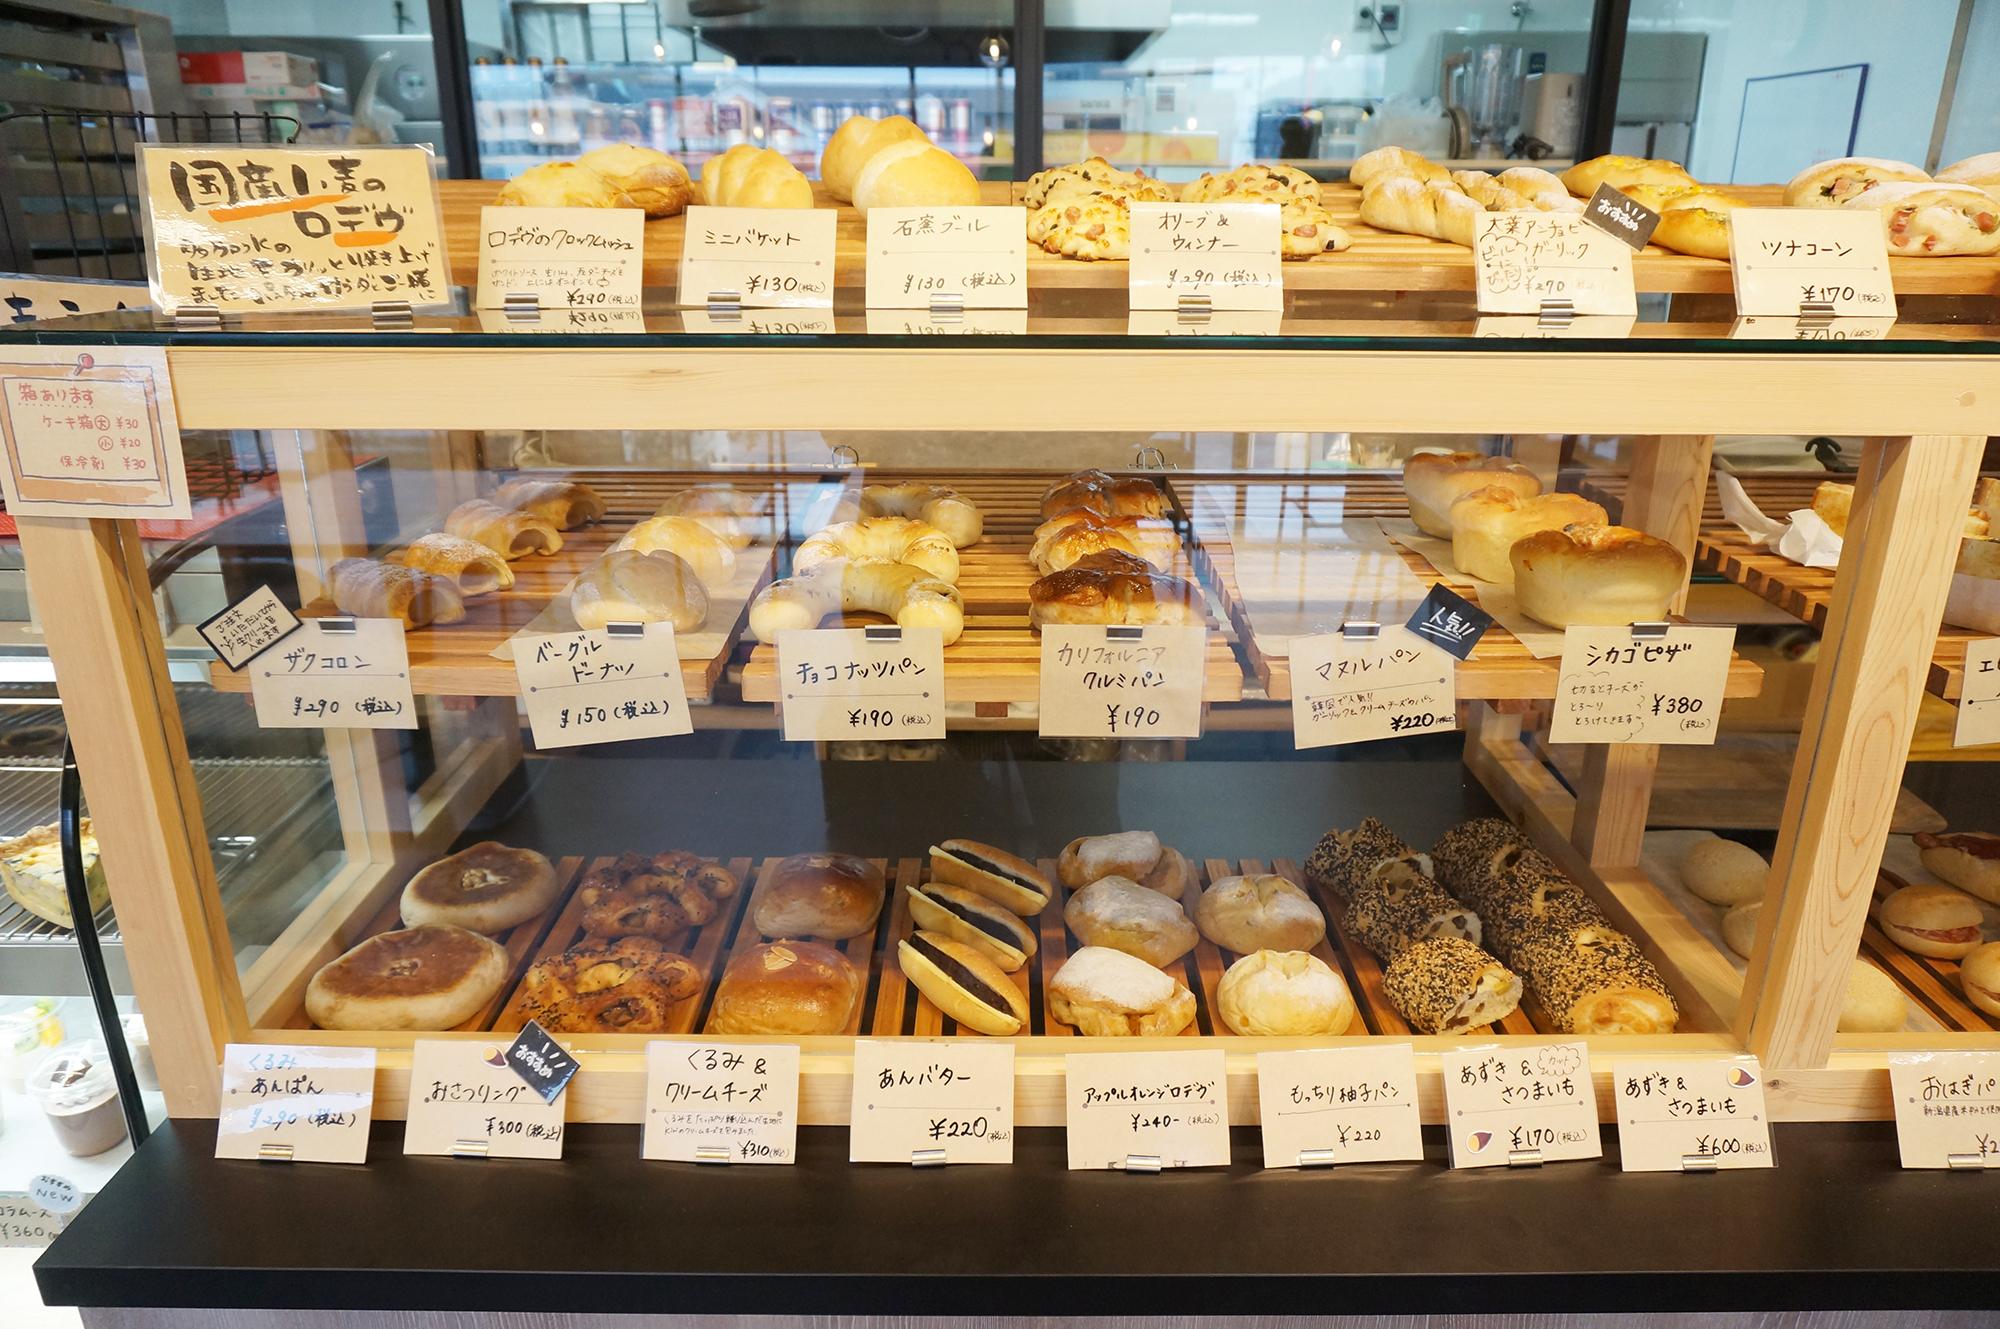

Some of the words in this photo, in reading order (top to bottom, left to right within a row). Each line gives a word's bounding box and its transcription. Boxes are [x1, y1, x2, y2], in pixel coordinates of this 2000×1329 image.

[170, 156, 386, 212] 国産小麦の
[293, 203, 413, 239] ロデヴ
[1158, 212, 1206, 230] オリーブ
[704, 230, 800, 247] ミニバケット
[1172, 238, 1240, 251] ウィンナー
[1532, 240, 1589, 259] ガーリック
[1762, 240, 1853, 257] ツナコーン
[746, 274, 798, 293] ¥130
[904, 274, 945, 294] ¥130
[961, 272, 1016, 289] (税込)
[1169, 269, 1214, 290] ¥290
[1526, 275, 1565, 294] ¥270
[566, 288, 606, 306] ¥290
[1801, 285, 1854, 303] ¥170
[18, 383, 94, 405] 箱あります
[115, 418, 139, 429] ¥30
[119, 438, 141, 448] ¥20
[60, 456, 105, 470] 保冷剤
[123, 458, 146, 470] ¥30
[284, 648, 371, 672] ザクコロン
[537, 635, 602, 663] ベーグル
[1058, 643, 1166, 666] カリフォルニア
[1587, 642, 1692, 666] シカゴピザ
[572, 661, 634, 683] ドーナツ
[796, 657, 926, 684] チョコナッツパン
[1315, 649, 1421, 680] マヌルパン
[1978, 658, 2000, 673] エ
[1083, 671, 1166, 689] クルミパン
[293, 696, 339, 717] ¥290
[355, 697, 402, 715] (税込)
[560, 706, 606, 728] ¥150
[614, 700, 670, 720] (税込)
[1651, 693, 1703, 716] ¥380
[848, 709, 893, 727] ¥190
[901, 714, 931, 726] (税込)
[1107, 704, 1160, 733] ¥190
[1390, 713, 1434, 731] ¥220
[250, 1053, 297, 1070] くるみ
[688, 1049, 744, 1071] くるみ
[754, 1058, 767, 1075] &
[1461, 1056, 1507, 1086] あずき
[1521, 1060, 1533, 1076] &
[251, 1074, 325, 1097] あんぱん
[878, 1064, 971, 1089] あんバター
[1625, 1072, 1669, 1098] あずき
[1676, 1077, 1687, 1090] &
[1920, 1074, 1996, 1101] おはぎパ
[666, 1082, 768, 1103] クリームチーズ
[1084, 1081, 1215, 1104] アップルオレンジロデヴ
[1290, 1081, 1399, 1104] もっちり柚子パン
[1502, 1078, 1574, 1104] さつまいも
[1668, 1097, 1736, 1117] さつまいも
[250, 1107, 297, 1131] ¥290
[485, 1117, 522, 1136] ¥300
[526, 1124, 562, 1141] (税込)
[929, 1116, 987, 1140] ¥220
[1337, 1124, 1381, 1148] ¥220
[1509, 1126, 1554, 1149] ¥170
[1557, 1128, 1587, 1145] (税込)
[1696, 1134, 1740, 1156] ¥600
[737, 1140, 769, 1159] ¥310
